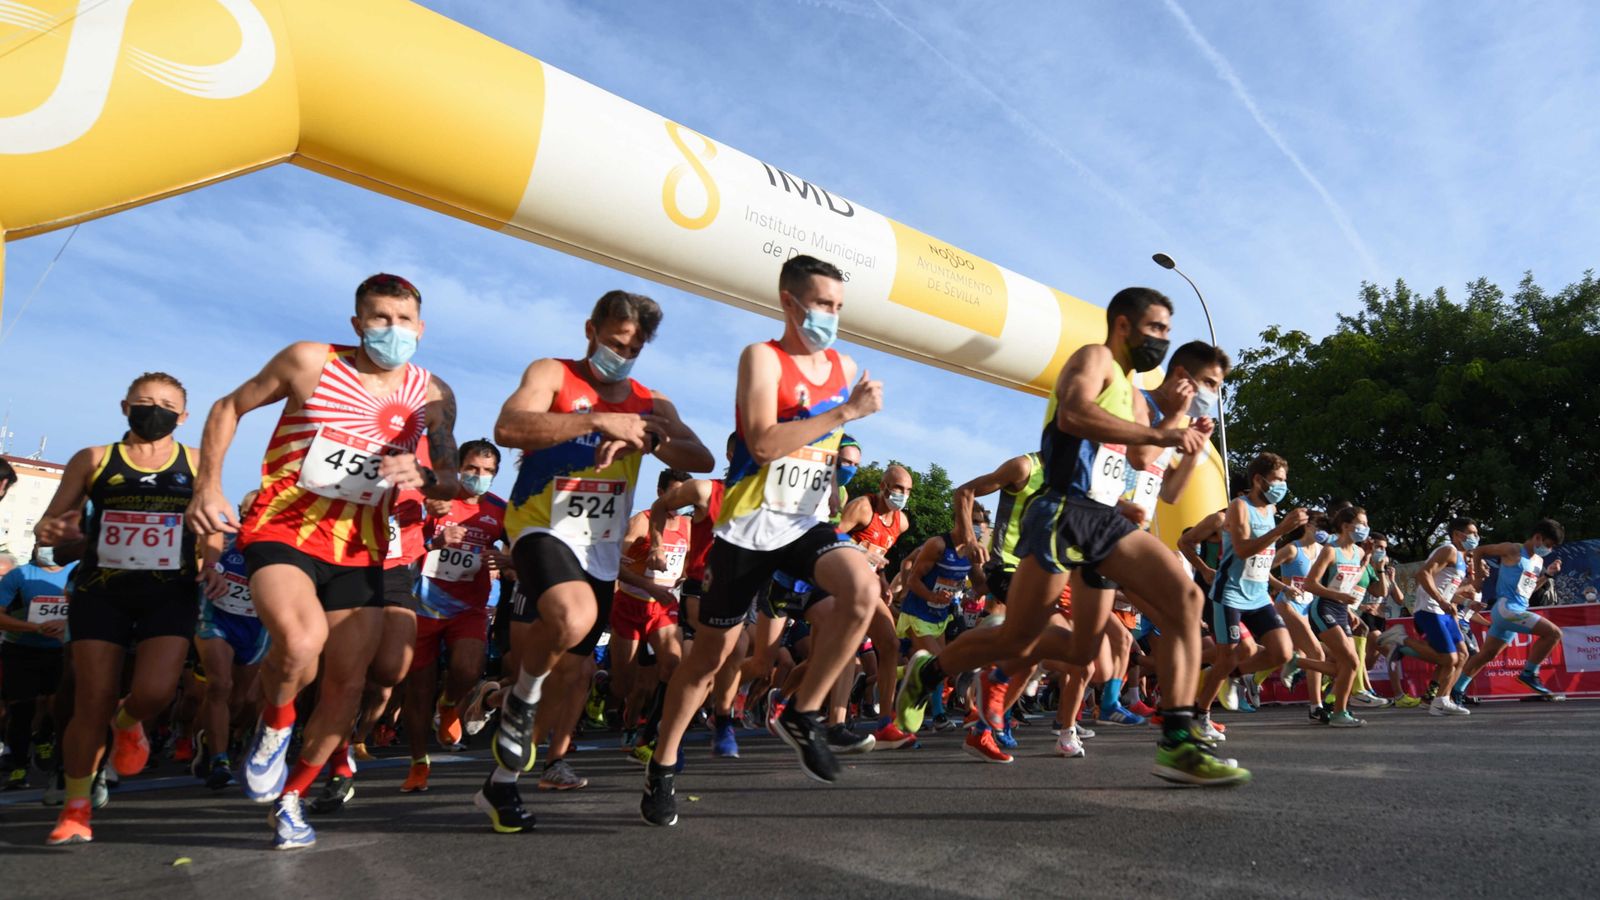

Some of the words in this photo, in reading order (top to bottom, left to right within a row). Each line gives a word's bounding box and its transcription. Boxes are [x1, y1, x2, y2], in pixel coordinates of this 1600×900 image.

[761, 161, 854, 218] IMD
[744, 205, 806, 242] Instituto
[811, 231, 877, 269] Municipal
[762, 240, 783, 258] de
[927, 278, 941, 292] DE
[325, 449, 382, 480] 453
[1103, 455, 1125, 482] 66
[567, 496, 615, 518] 524
[105, 526, 174, 547] 8761
[439, 548, 474, 568] 906
[666, 554, 682, 566] 57
[226, 582, 252, 601] 23
[39, 604, 70, 616] 546
